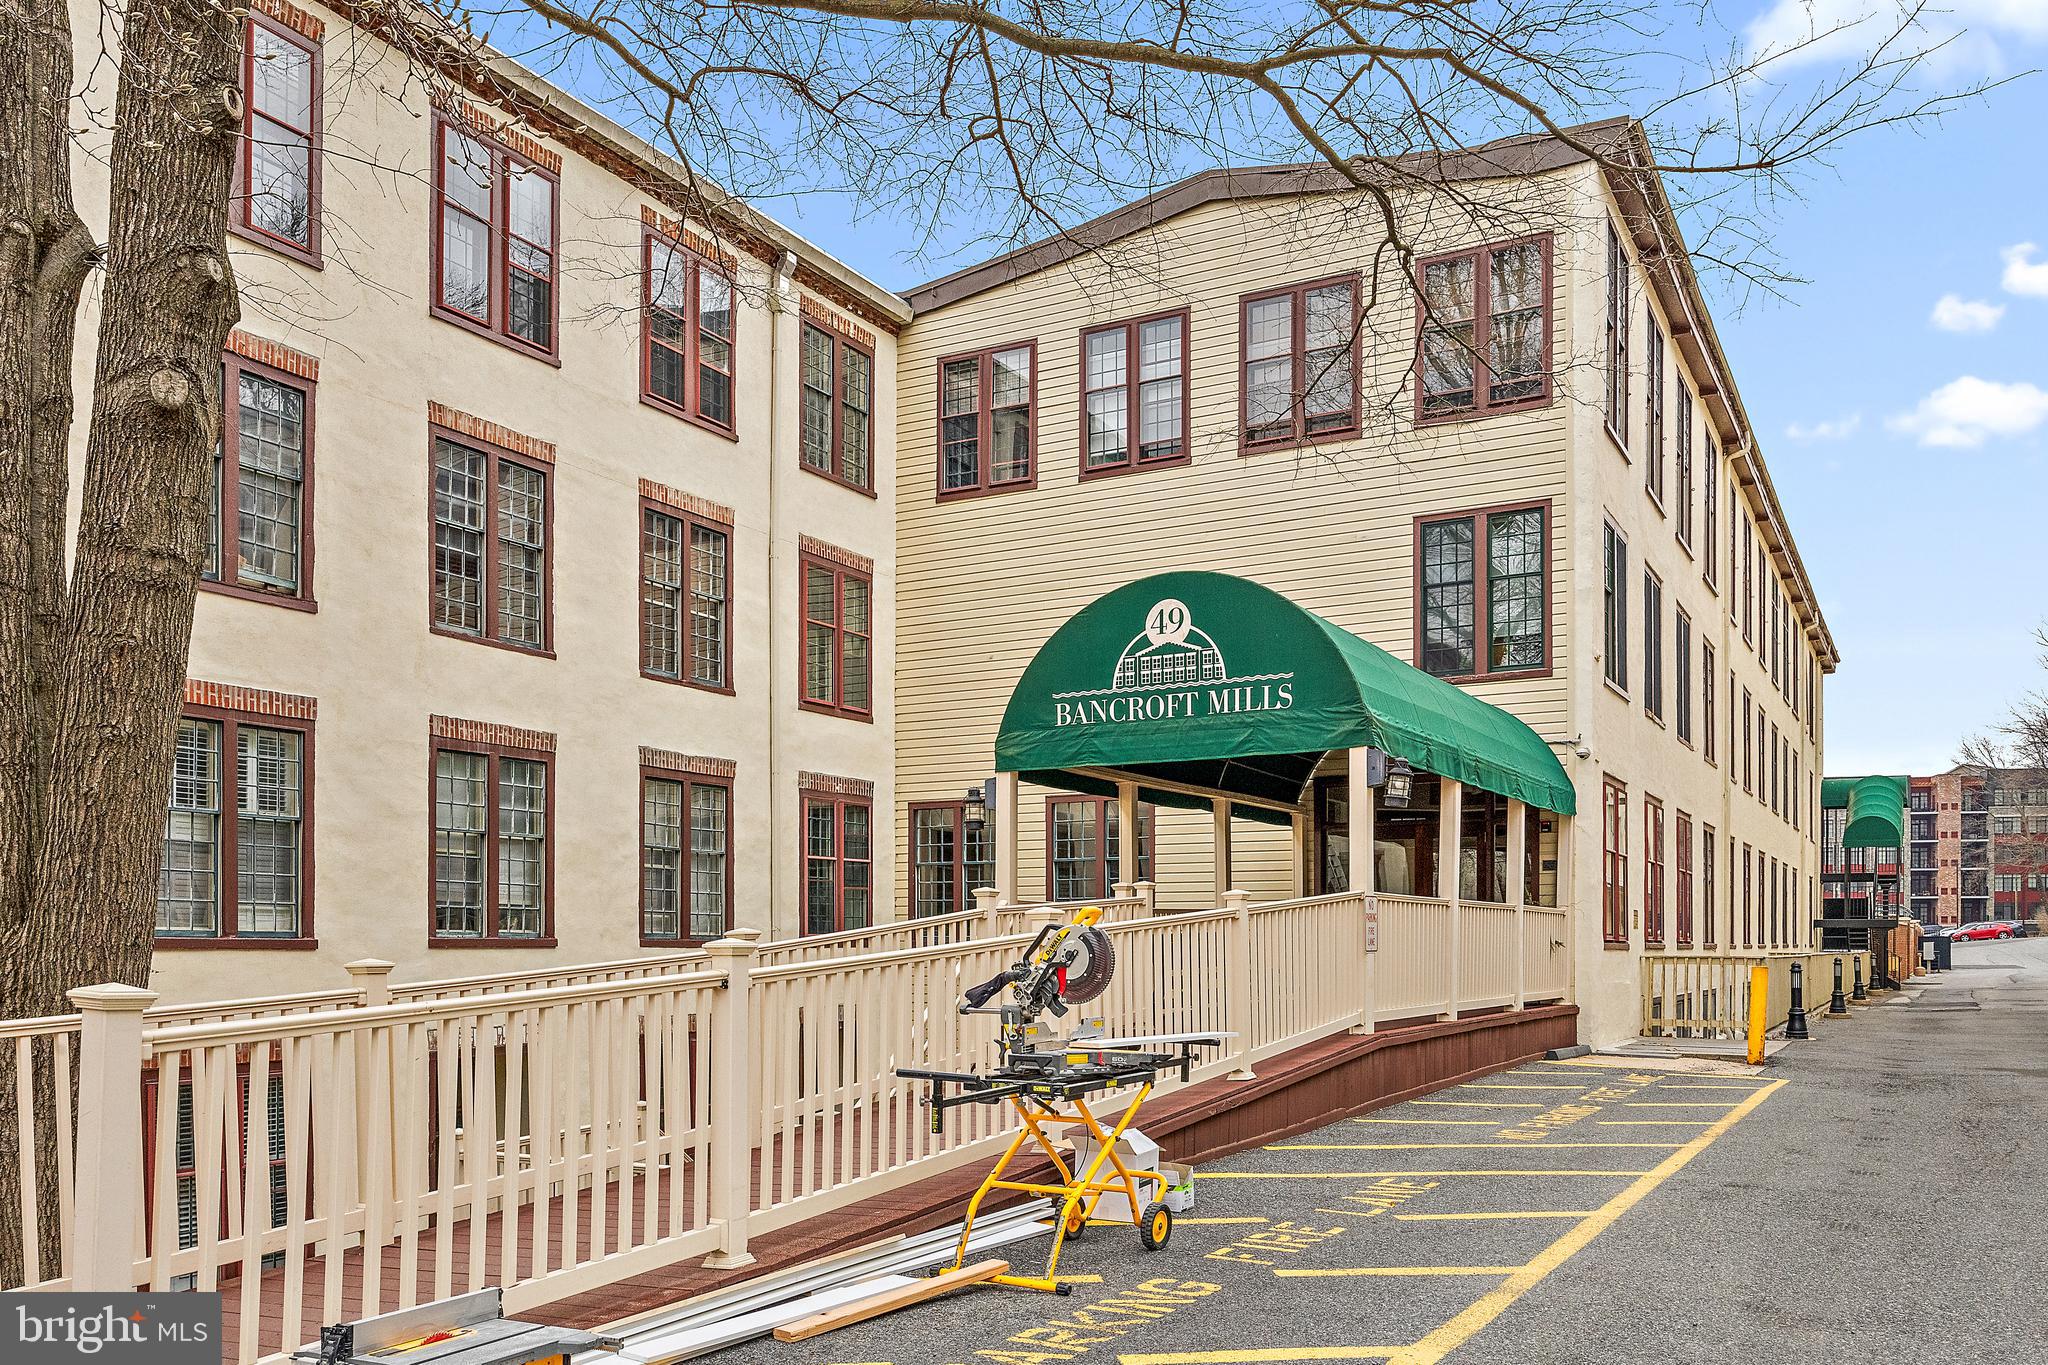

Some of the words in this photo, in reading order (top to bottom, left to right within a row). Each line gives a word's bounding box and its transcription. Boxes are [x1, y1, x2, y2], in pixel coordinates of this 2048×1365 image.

[1150, 607, 1184, 635] 49
[1055, 692, 1199, 727] BANCROFT
[1208, 683, 1294, 715] MILLS
[945, 1278, 1222, 1365] ARKING
[1203, 1221, 1346, 1266] FIRE
[1314, 1178, 1441, 1217] LANE
